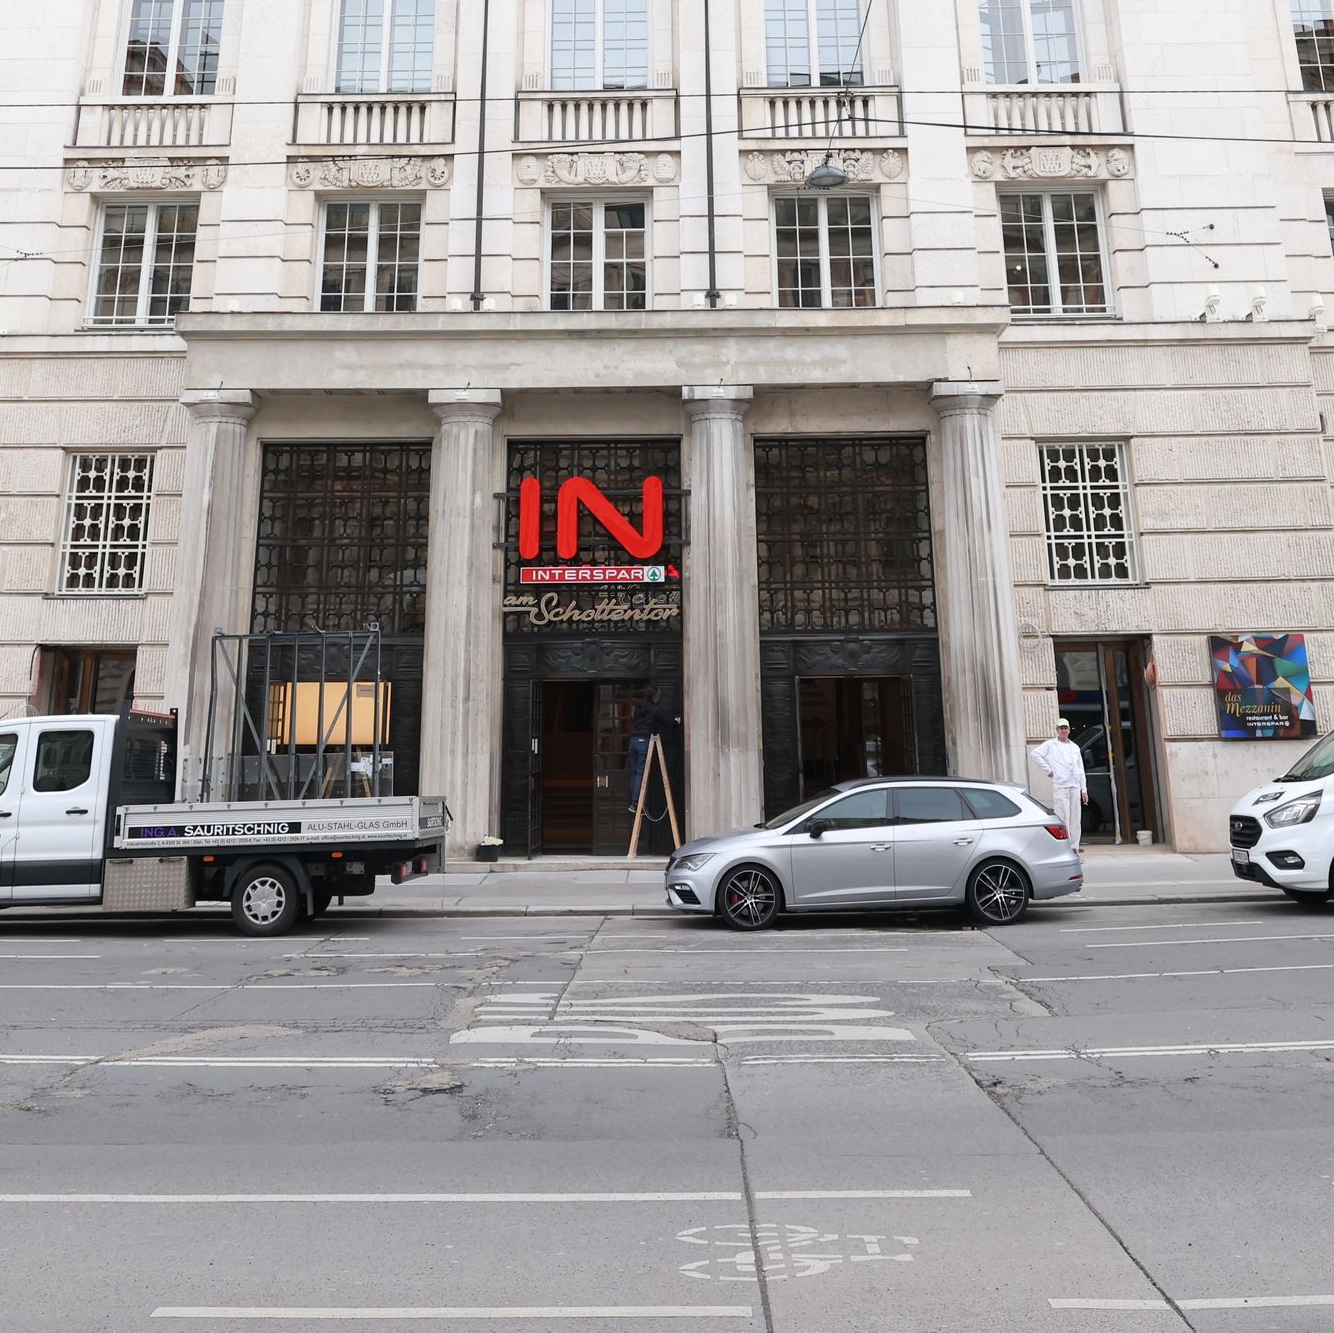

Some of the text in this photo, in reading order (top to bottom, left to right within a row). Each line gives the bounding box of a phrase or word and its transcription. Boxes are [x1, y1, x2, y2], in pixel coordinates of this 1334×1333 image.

[519, 476, 664, 560] IN
[532, 569, 643, 580] INTERSPAR
[503, 595, 538, 606] am
[504, 592, 679, 626] Schottentor
[1224, 691, 1242, 702] das
[1226, 702, 1281, 717] Mezzanin
[140, 820, 408, 837] ING. A. SAURITSCHNIG ALU-STAHL-GLAS GmbH
